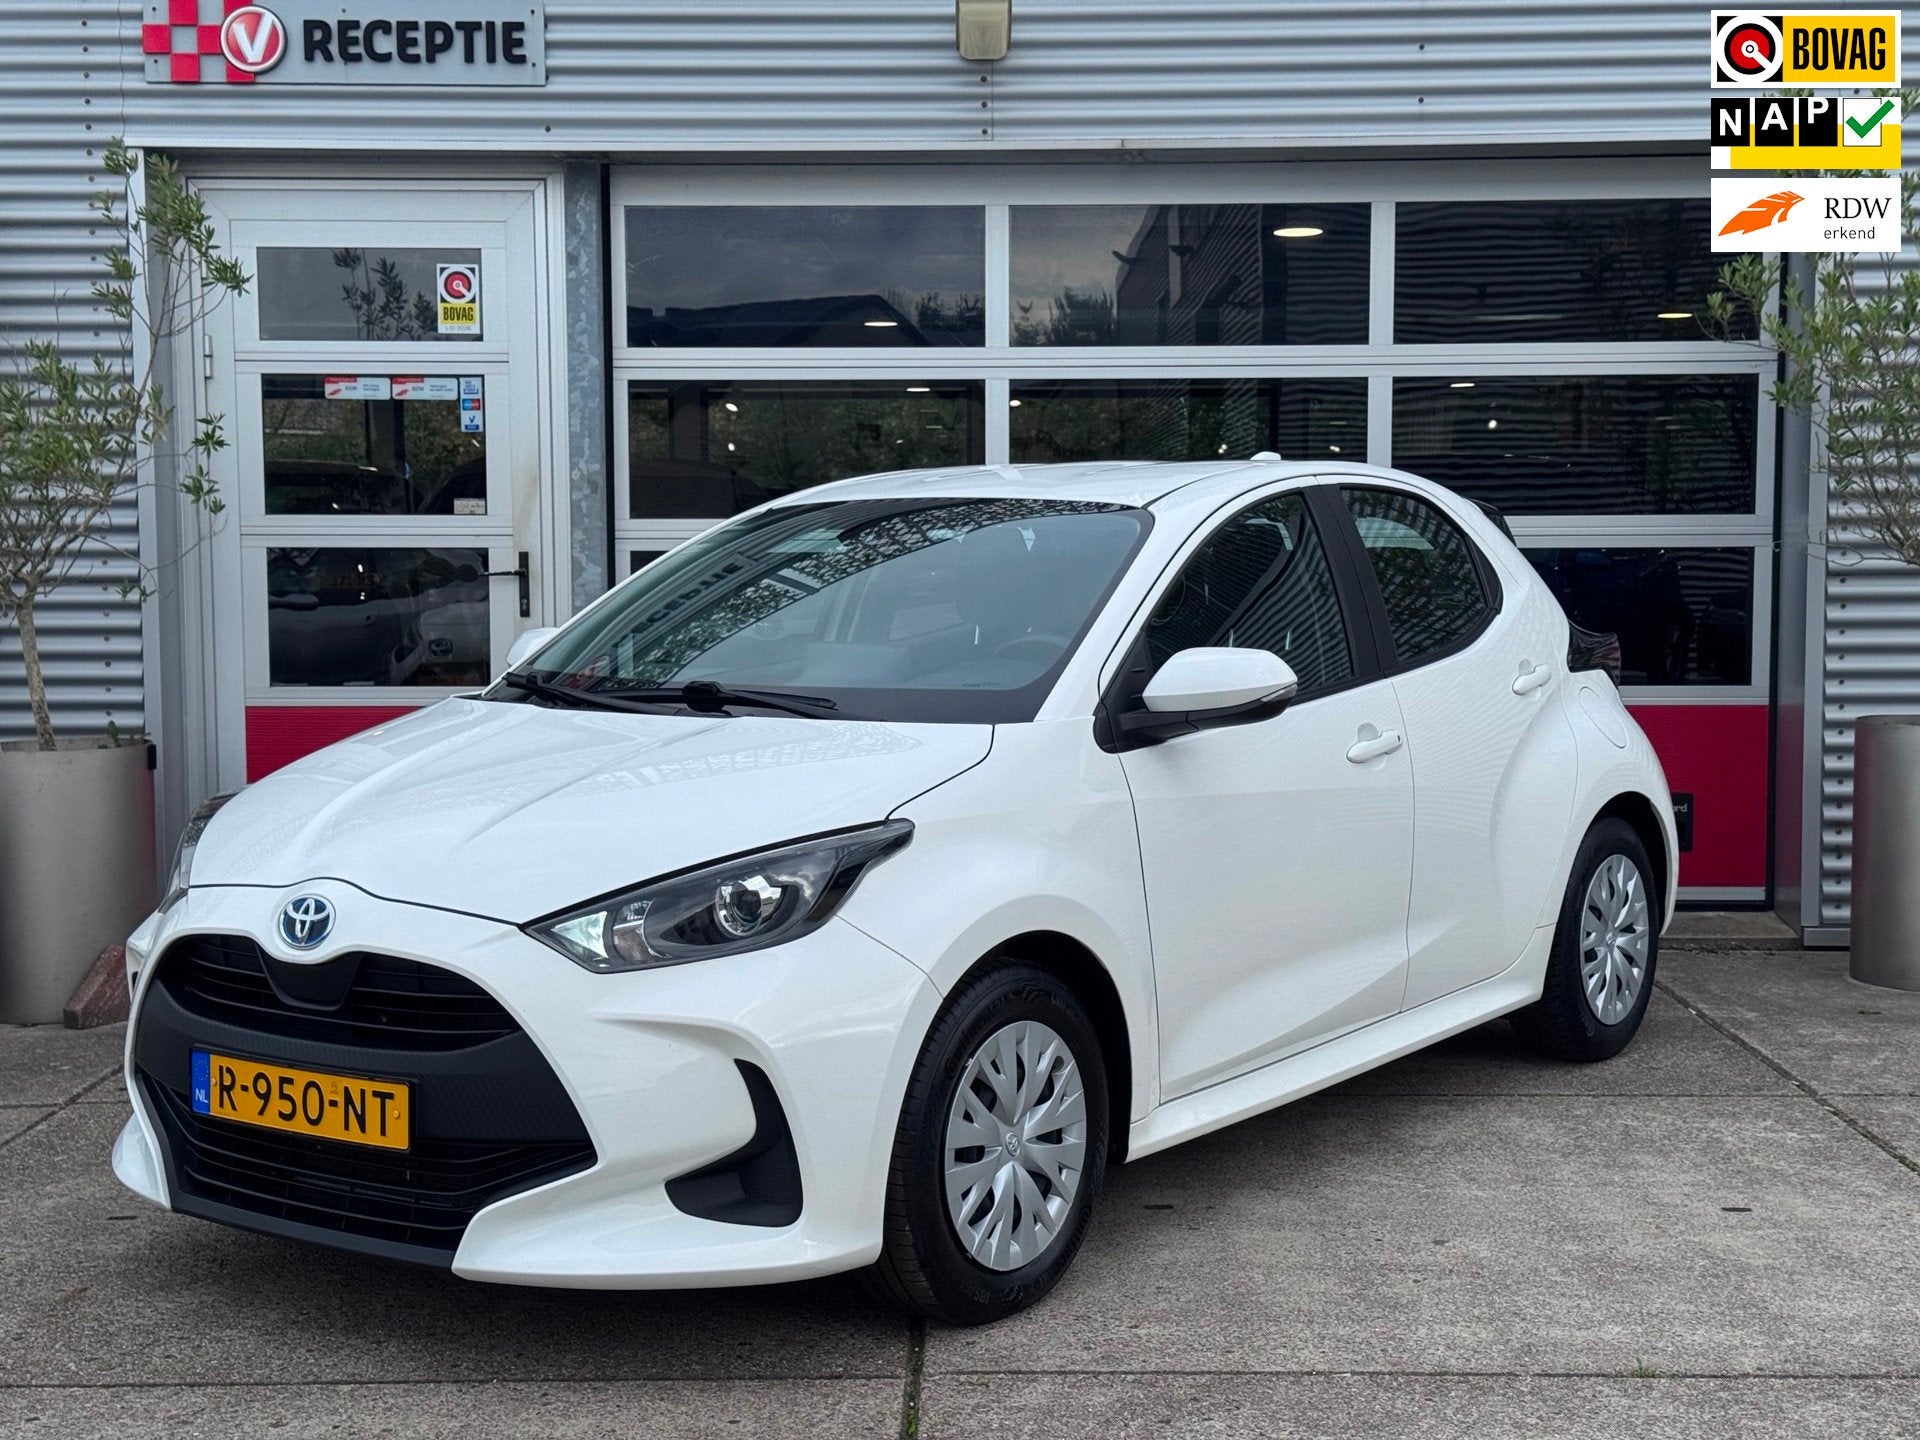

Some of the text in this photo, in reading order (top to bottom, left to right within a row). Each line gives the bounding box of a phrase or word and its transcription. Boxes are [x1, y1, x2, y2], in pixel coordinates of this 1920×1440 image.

[303, 18, 527, 65] RECEPTIE
[443, 306, 474, 321] BOVAG
[195, 1087, 209, 1104] NL
[218, 1064, 395, 1138] R-950-NT
